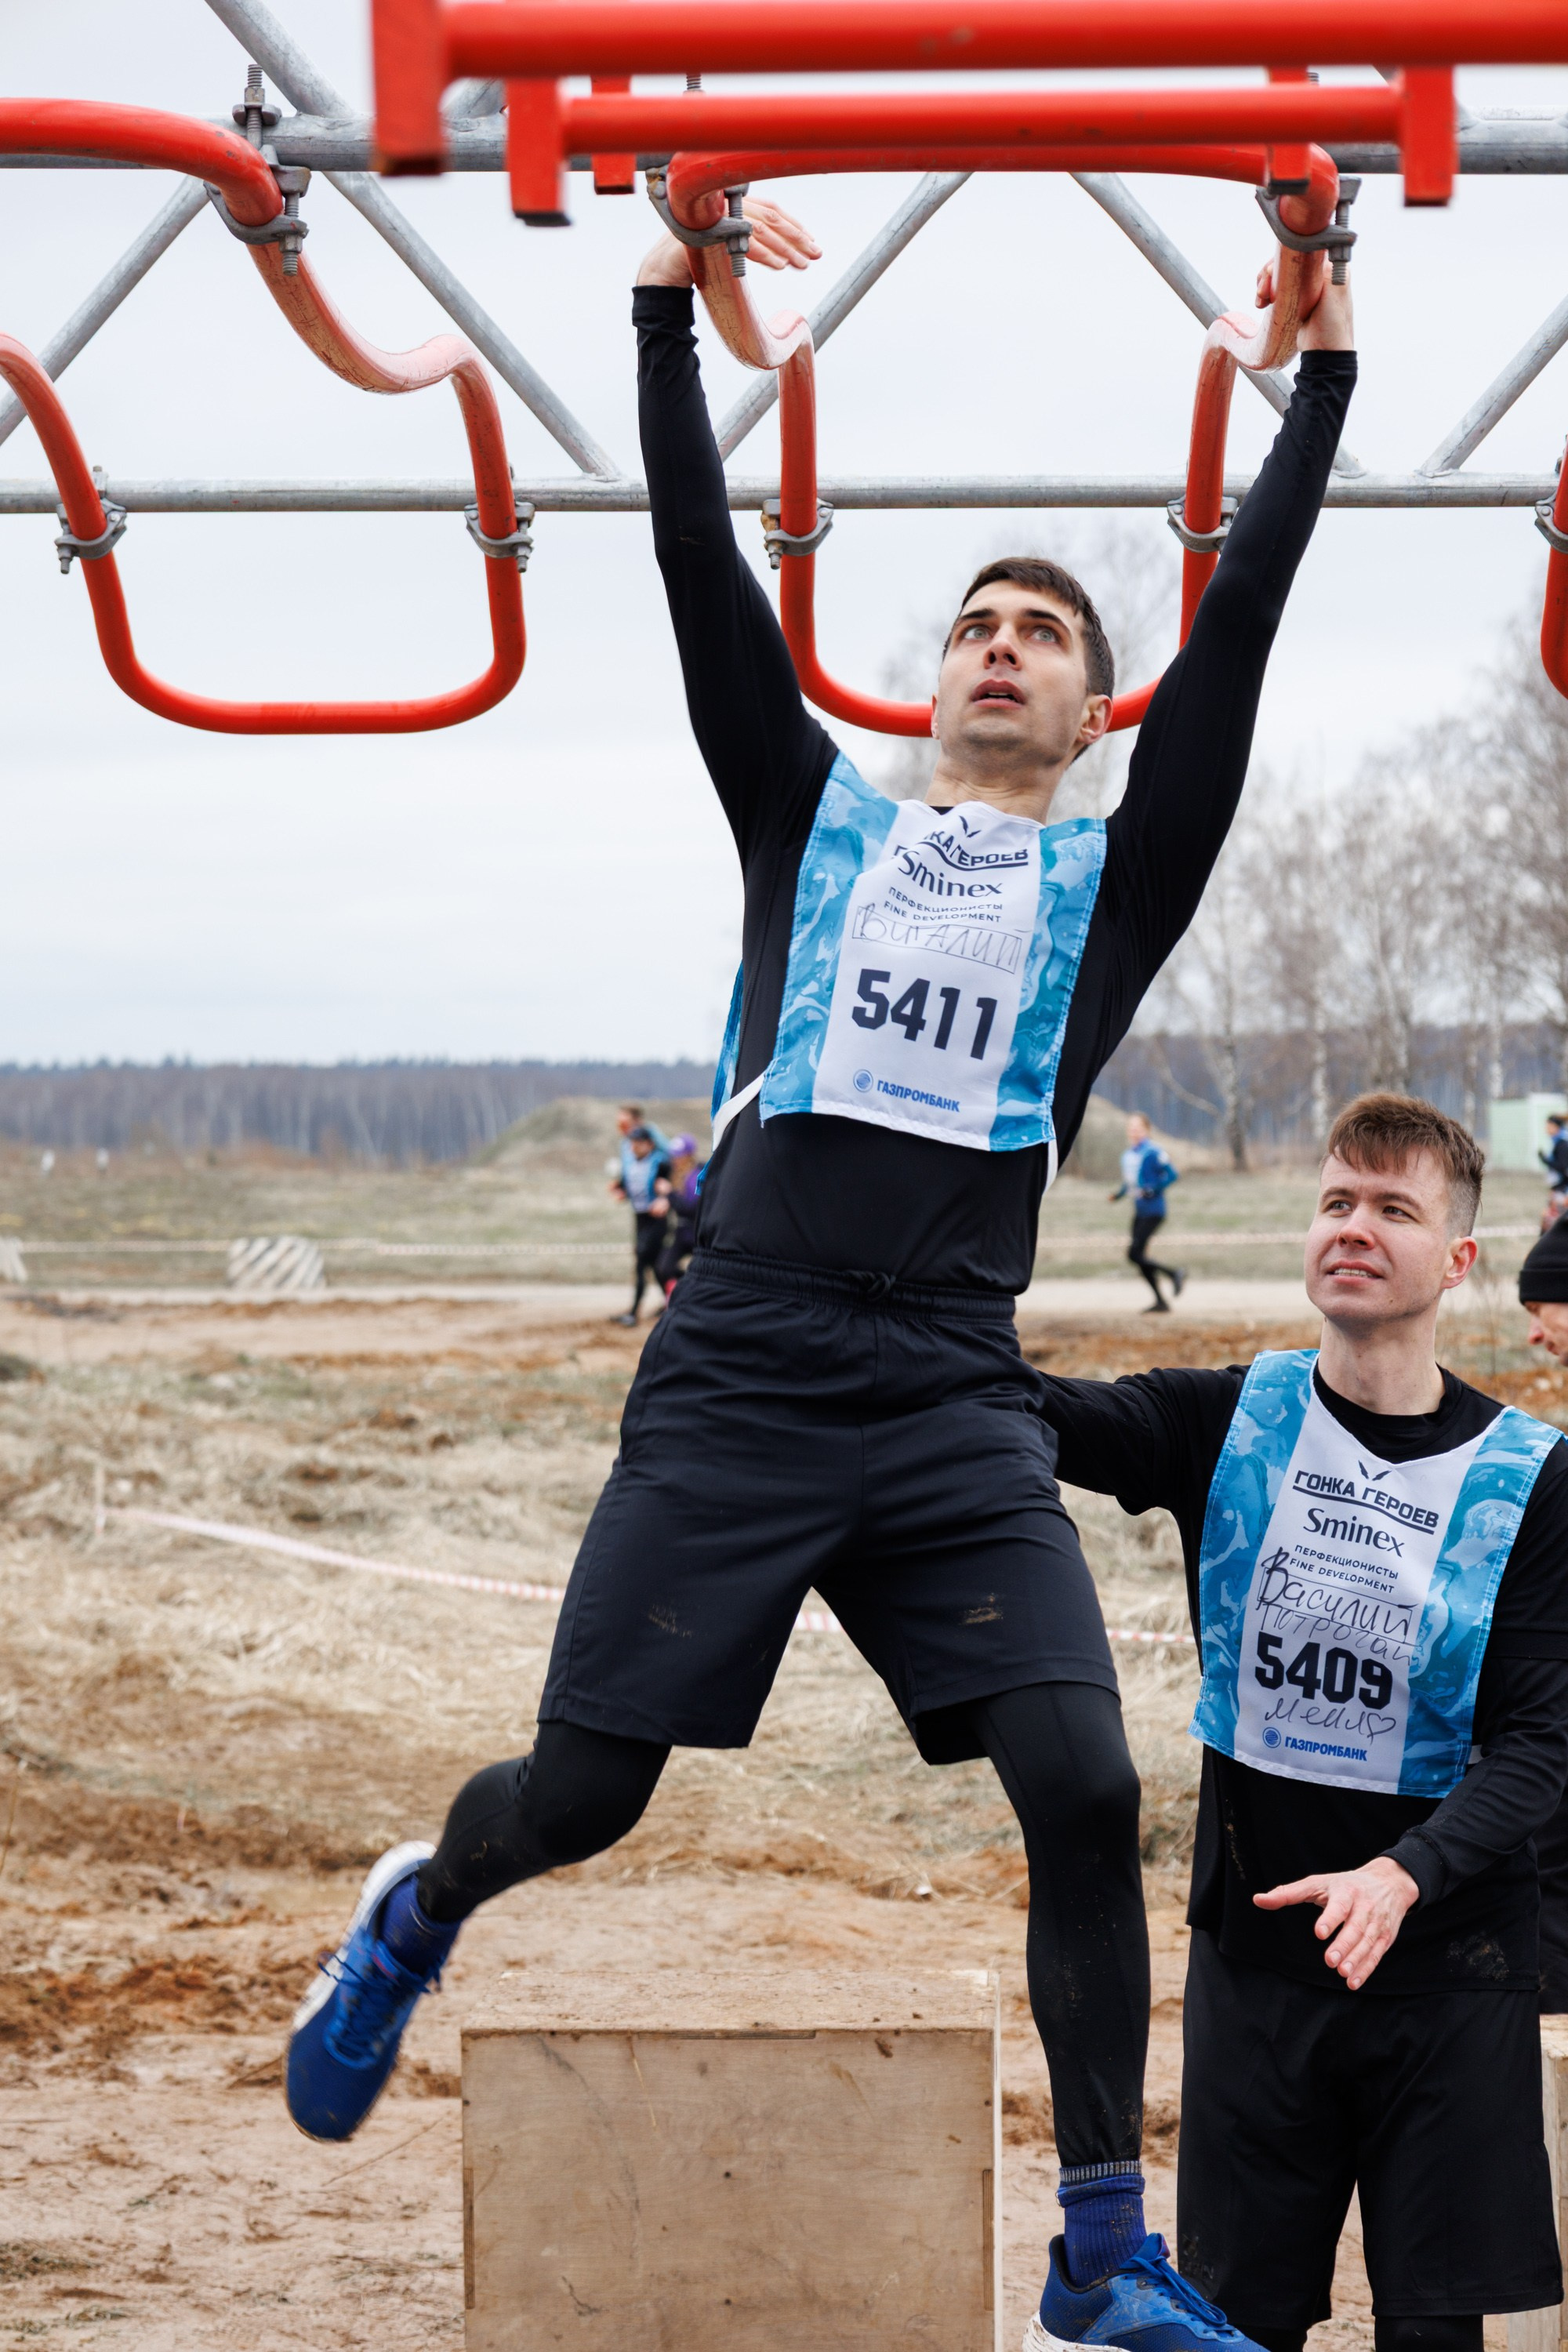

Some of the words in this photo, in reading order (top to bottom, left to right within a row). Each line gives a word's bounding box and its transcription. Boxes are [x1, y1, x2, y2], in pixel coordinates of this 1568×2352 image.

[898, 851, 1003, 898] Sminex
[884, 901, 907, 918] FINE
[913, 913, 1002, 923] DEVELOPMENT
[888, 887, 1003, 912] ПЕРФЕКЦИОНИСТЫ
[851, 968, 997, 1060] 5411
[877, 1080, 960, 1112] ГАЗПРОМБАНК
[1294, 1470, 1355, 1497] ГОНКА
[1362, 1487, 1439, 1528] ГЕРОЕВ
[1303, 1508, 1405, 1558] Sminex
[1290, 1558, 1315, 1573] FINE
[1318, 1567, 1395, 1594] DEVELOPMENT
[1294, 1544, 1399, 1580] ПЕРФЕКЦИОНИСТЫ
[1256, 1547, 1418, 1636] Василий
[1255, 1632, 1393, 1710] 5409
[1284, 1736, 1367, 1762] ГАЗПРОМБАНК
